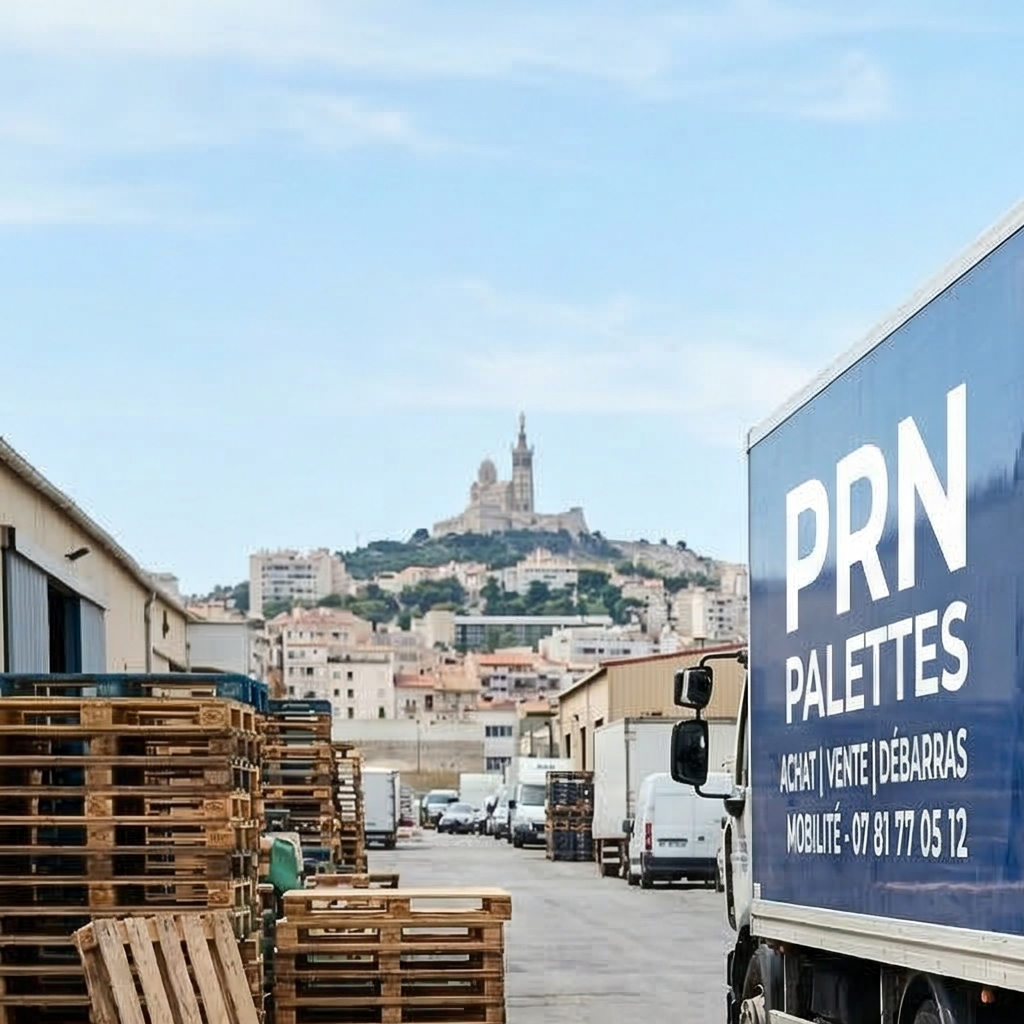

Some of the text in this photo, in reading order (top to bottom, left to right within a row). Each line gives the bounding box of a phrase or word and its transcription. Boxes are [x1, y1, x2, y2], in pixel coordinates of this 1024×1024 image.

[786, 383, 966, 634] PRN
[786, 601, 968, 724] PALETTES
[780, 751, 817, 793] ACHAT
[826, 743, 868, 788] VENTE
[879, 726, 967, 784] DÉBARRAS
[787, 801, 841, 854] MOBILITÉ
[852, 812, 869, 855] 07
[873, 811, 889, 856] 81
[895, 810, 915, 856] 77
[920, 809, 942, 857] 05
[948, 808, 968, 857] 12
